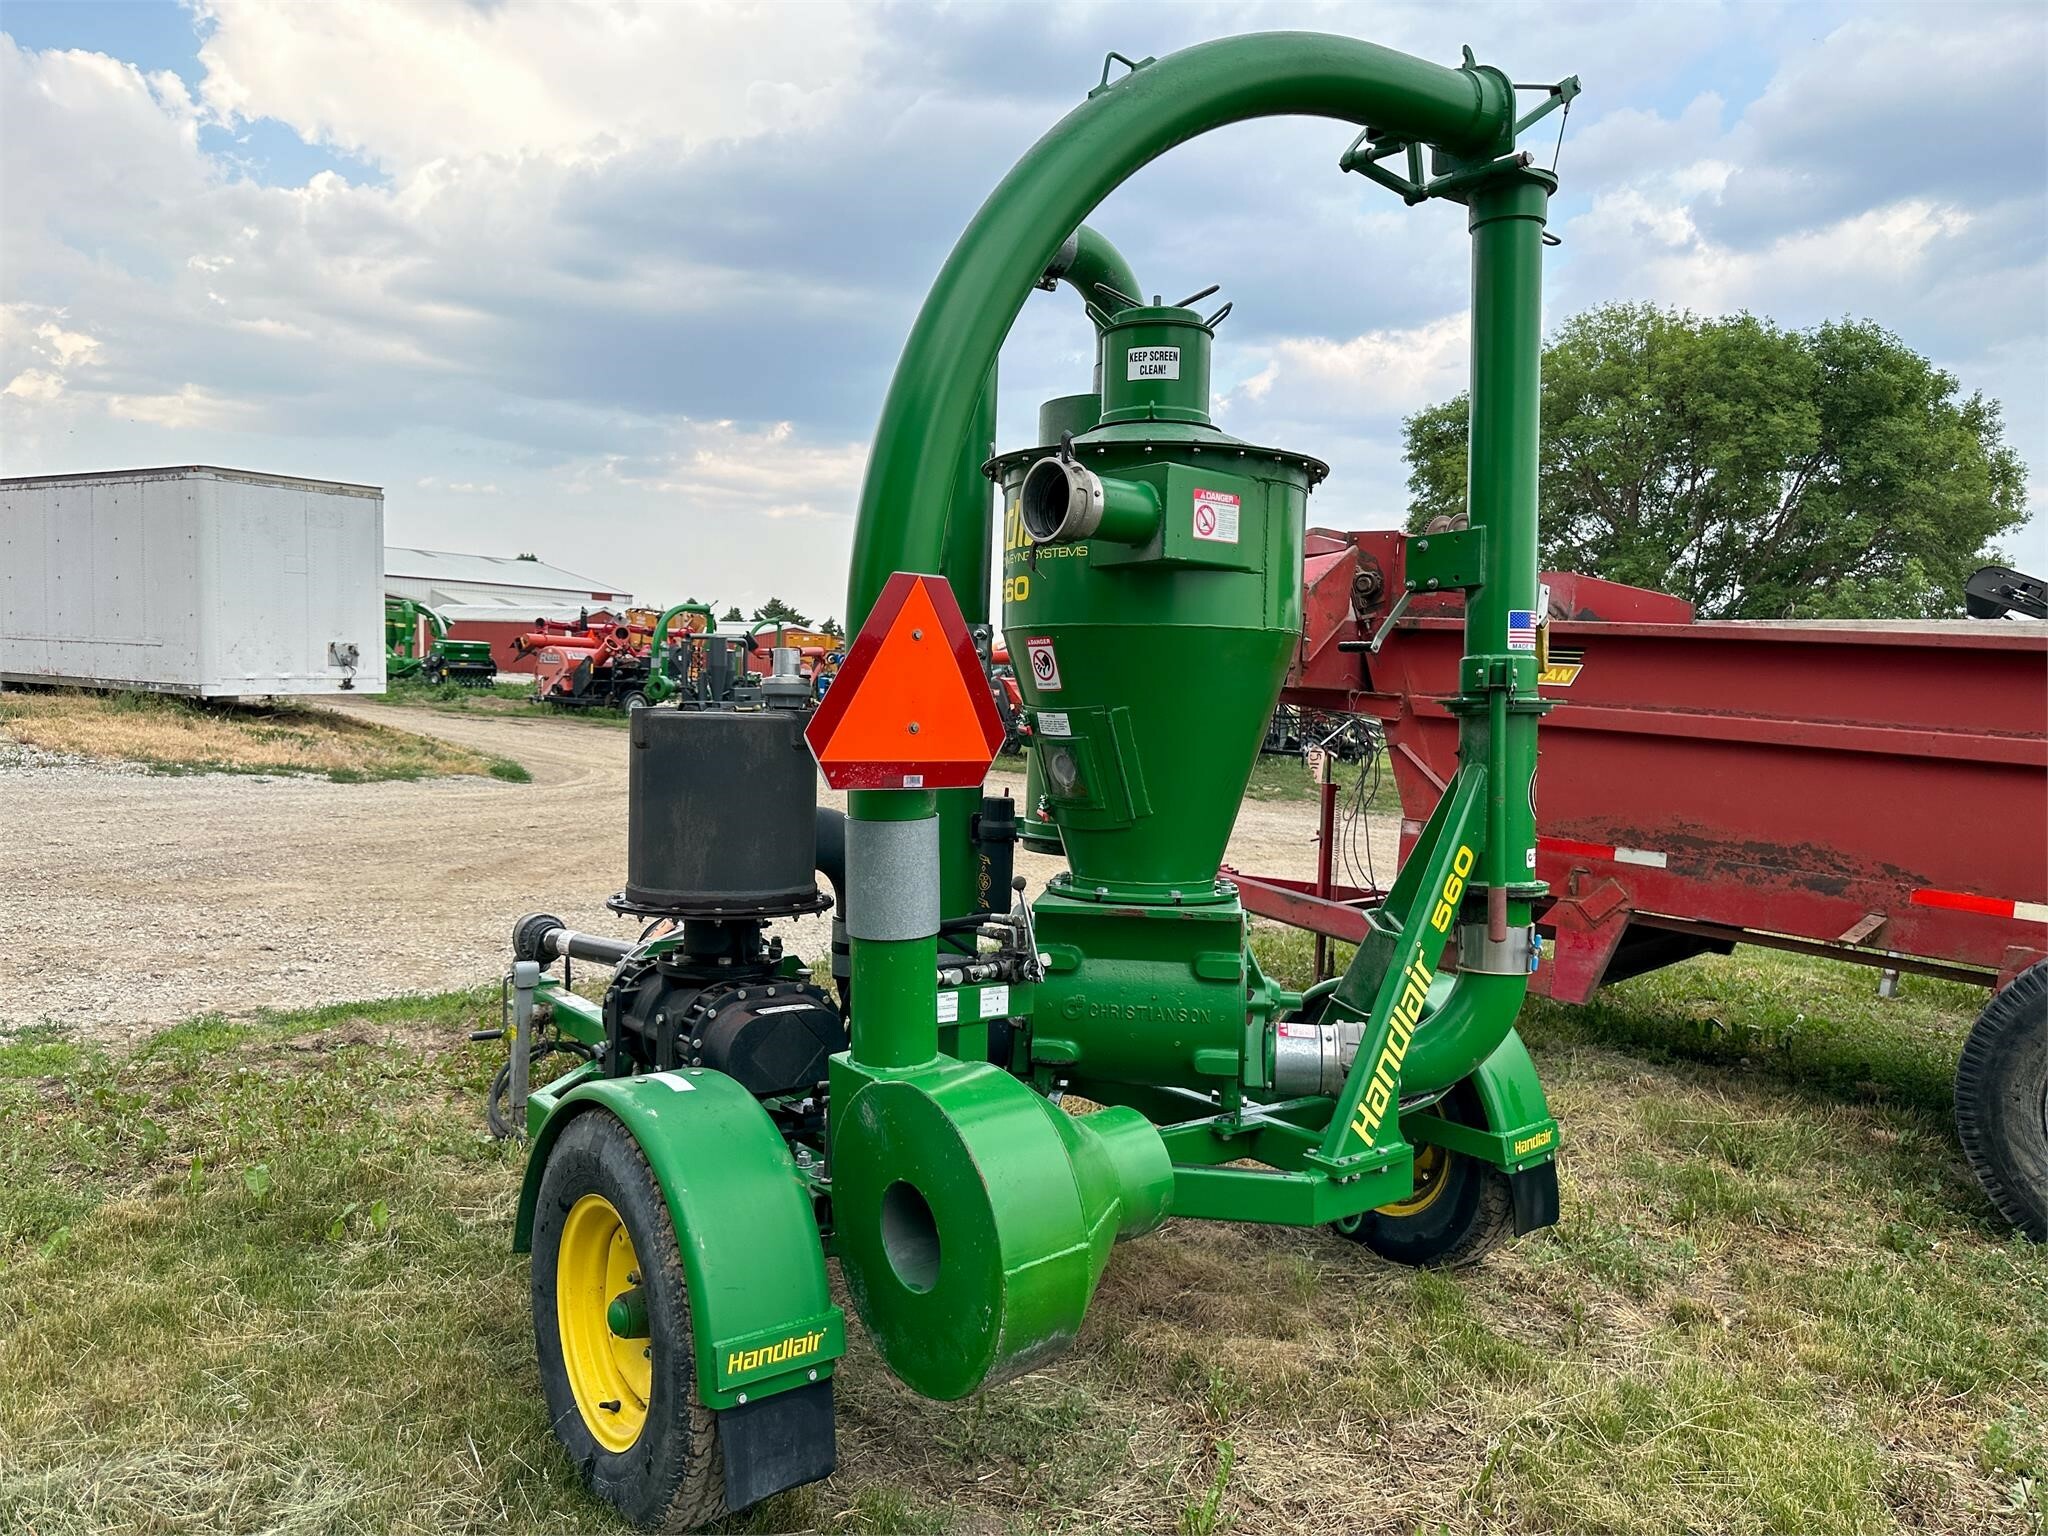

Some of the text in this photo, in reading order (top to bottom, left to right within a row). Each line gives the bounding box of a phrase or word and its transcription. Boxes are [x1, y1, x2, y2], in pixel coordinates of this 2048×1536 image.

[1129, 350, 1178, 362] KEEP SCREEN
[1139, 364, 1167, 375] CLEAN!
[1206, 491, 1234, 504] DANGER
[1351, 845, 1474, 1148] Handlair 560
[1089, 1002, 1212, 1024] CHRISTIANSON
[1514, 1128, 1553, 1156] Handlair
[727, 1331, 825, 1375] Handlair
